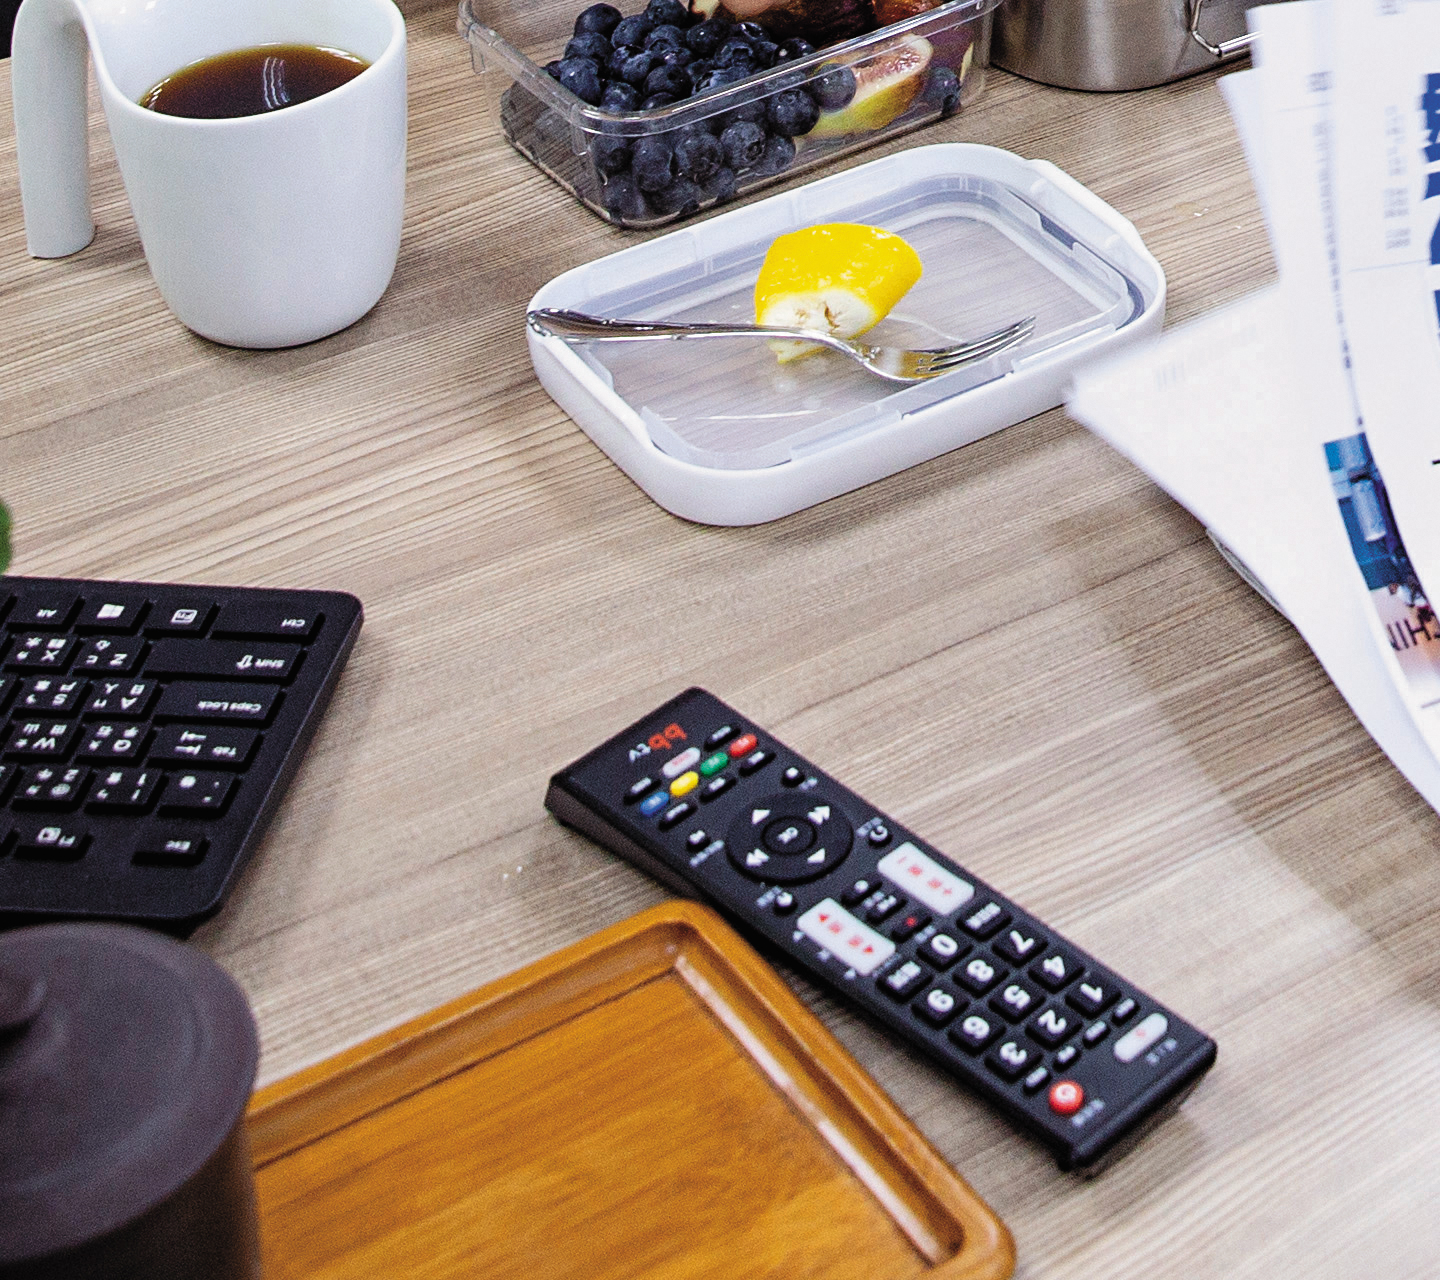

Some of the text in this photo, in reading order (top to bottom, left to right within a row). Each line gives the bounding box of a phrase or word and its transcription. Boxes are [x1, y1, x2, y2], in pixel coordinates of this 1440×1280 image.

[37, 608, 57, 617] Alt
[281, 618, 305, 628] Ctrl
[42, 649, 59, 660] X
[111, 653, 127, 665] Z
[256, 658, 285, 668] Shift
[52, 693, 67, 705] S
[121, 697, 138, 709] A
[198, 700, 229, 711] Lock
[230, 701, 262, 713] Caps
[32, 737, 57, 749] W
[115, 738, 132, 752] Q
[212, 746, 238, 756] Tab
[68, 768, 79, 780] 2
[138, 773, 148, 786] 1
[61, 835, 75, 845] F1
[166, 840, 191, 851] Esc
[934, 934, 957, 955] 0
[927, 929, 1034, 1012] 7 8 9
[962, 955, 1067, 1039] 4 5 6
[1000, 980, 1103, 1065] 1 2 3
